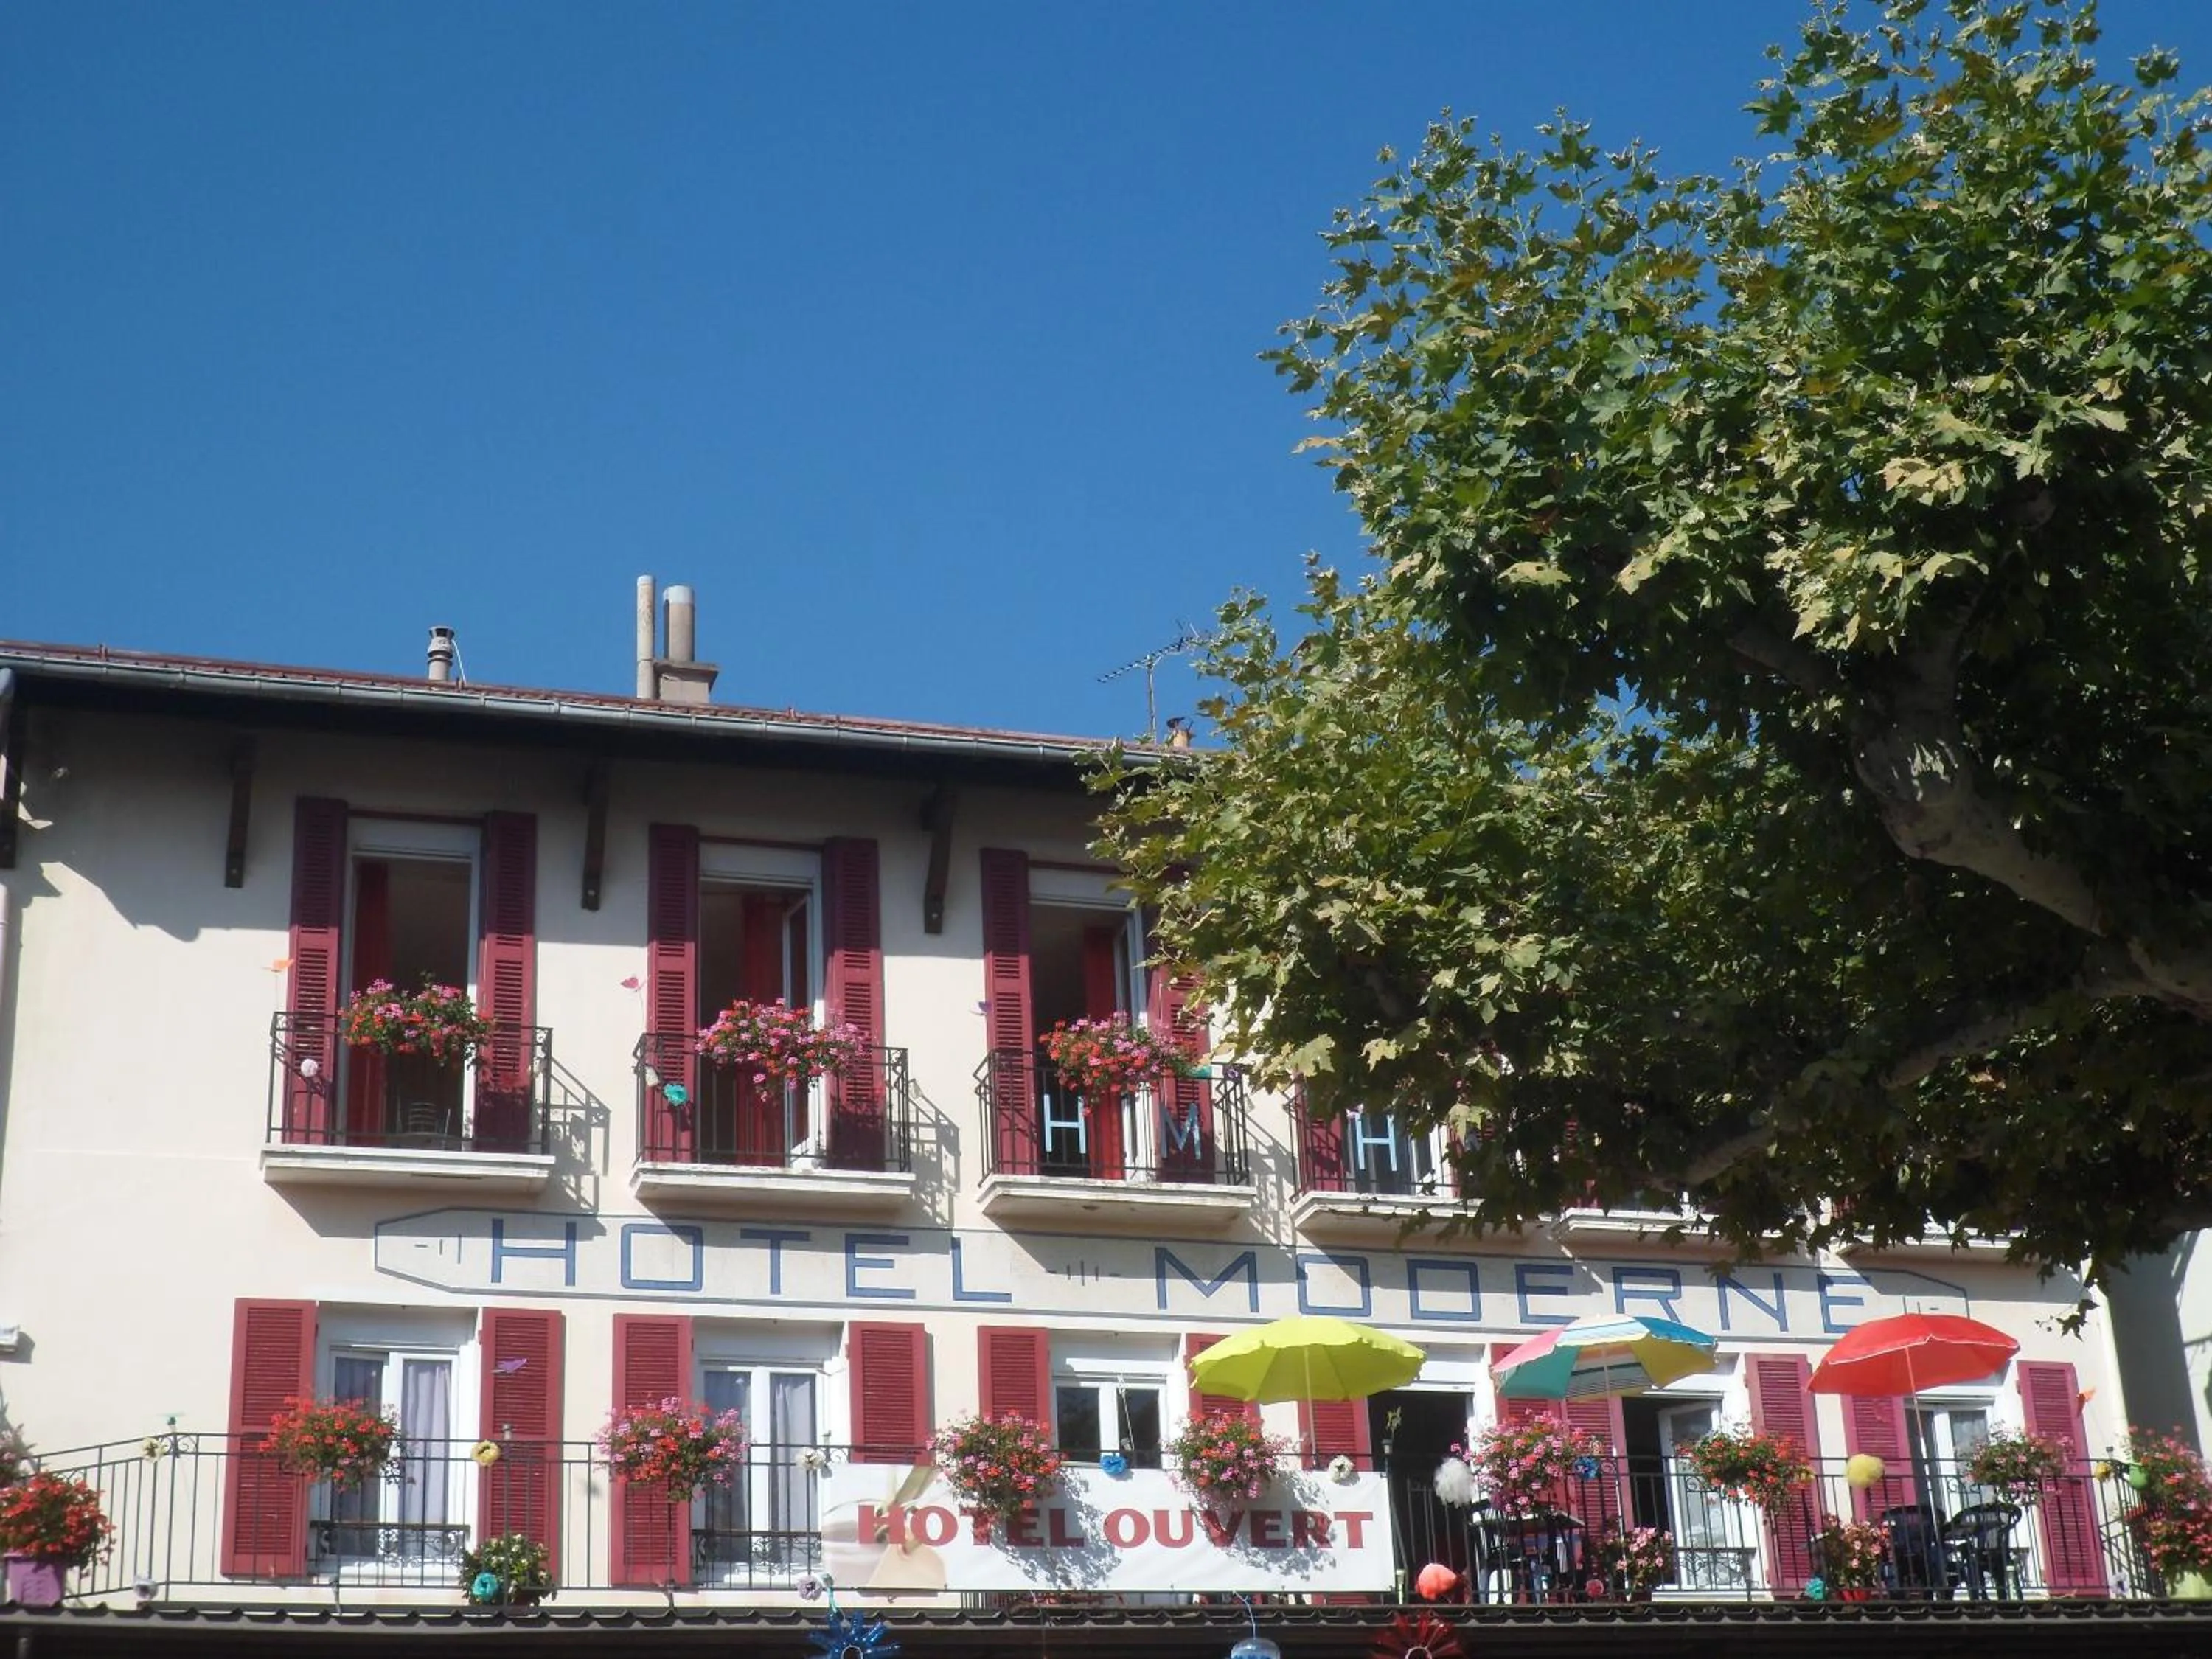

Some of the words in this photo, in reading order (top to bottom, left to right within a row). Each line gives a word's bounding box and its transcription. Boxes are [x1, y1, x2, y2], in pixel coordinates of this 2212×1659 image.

[491, 1217, 1012, 1303] HOTEL
[1154, 1245, 1871, 1335] MODERNE
[858, 1504, 1085, 1548] HOTEL
[1102, 1508, 1374, 1549] OUVERT
